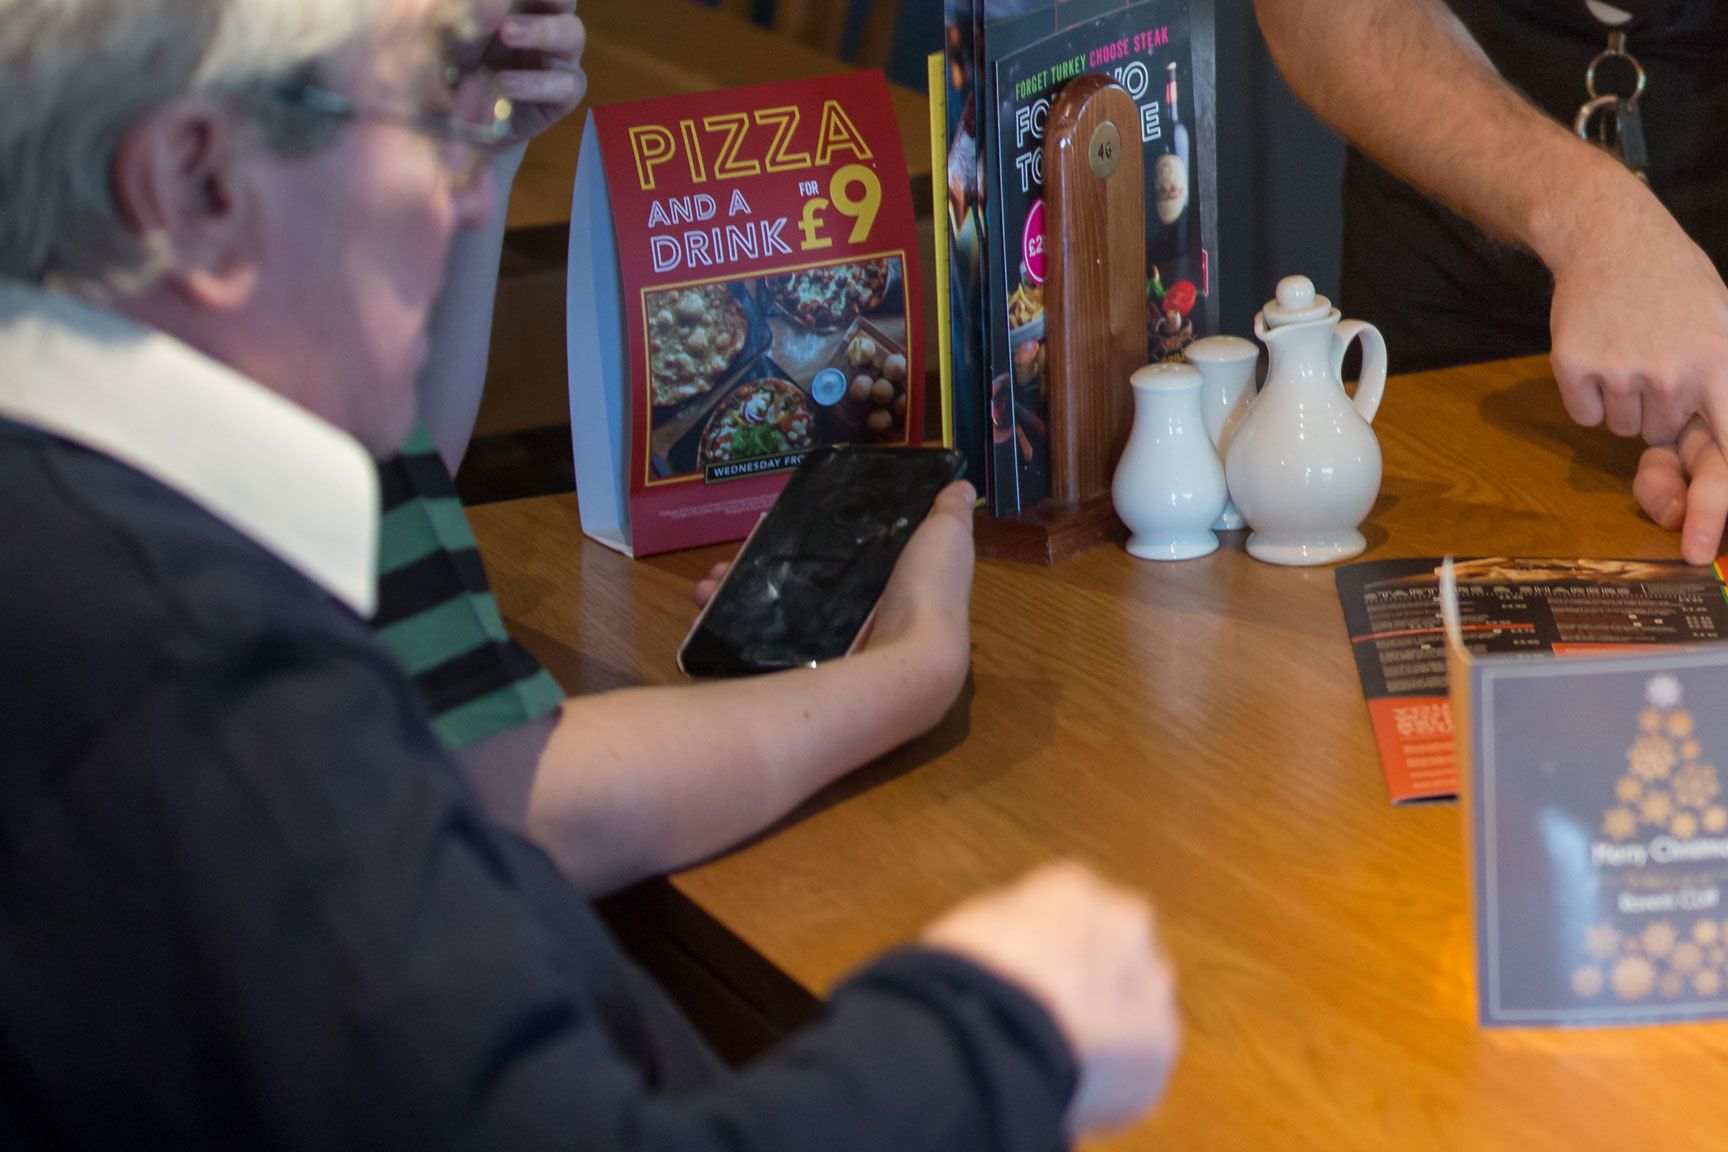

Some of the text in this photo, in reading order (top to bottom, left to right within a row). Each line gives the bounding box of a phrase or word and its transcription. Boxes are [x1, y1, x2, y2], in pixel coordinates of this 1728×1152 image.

[1015, 70, 1048, 101] FORGET
[1051, 53, 1087, 85] TURKEY
[1088, 37, 1131, 68] CHOOSE
[1133, 26, 1169, 53] STEAK
[628, 100, 874, 191] PIZZA
[648, 188, 752, 228] AND A
[799, 181, 819, 197] FOR
[650, 217, 793, 273] DRINK
[713, 455, 781, 478] WEDNESDAY
